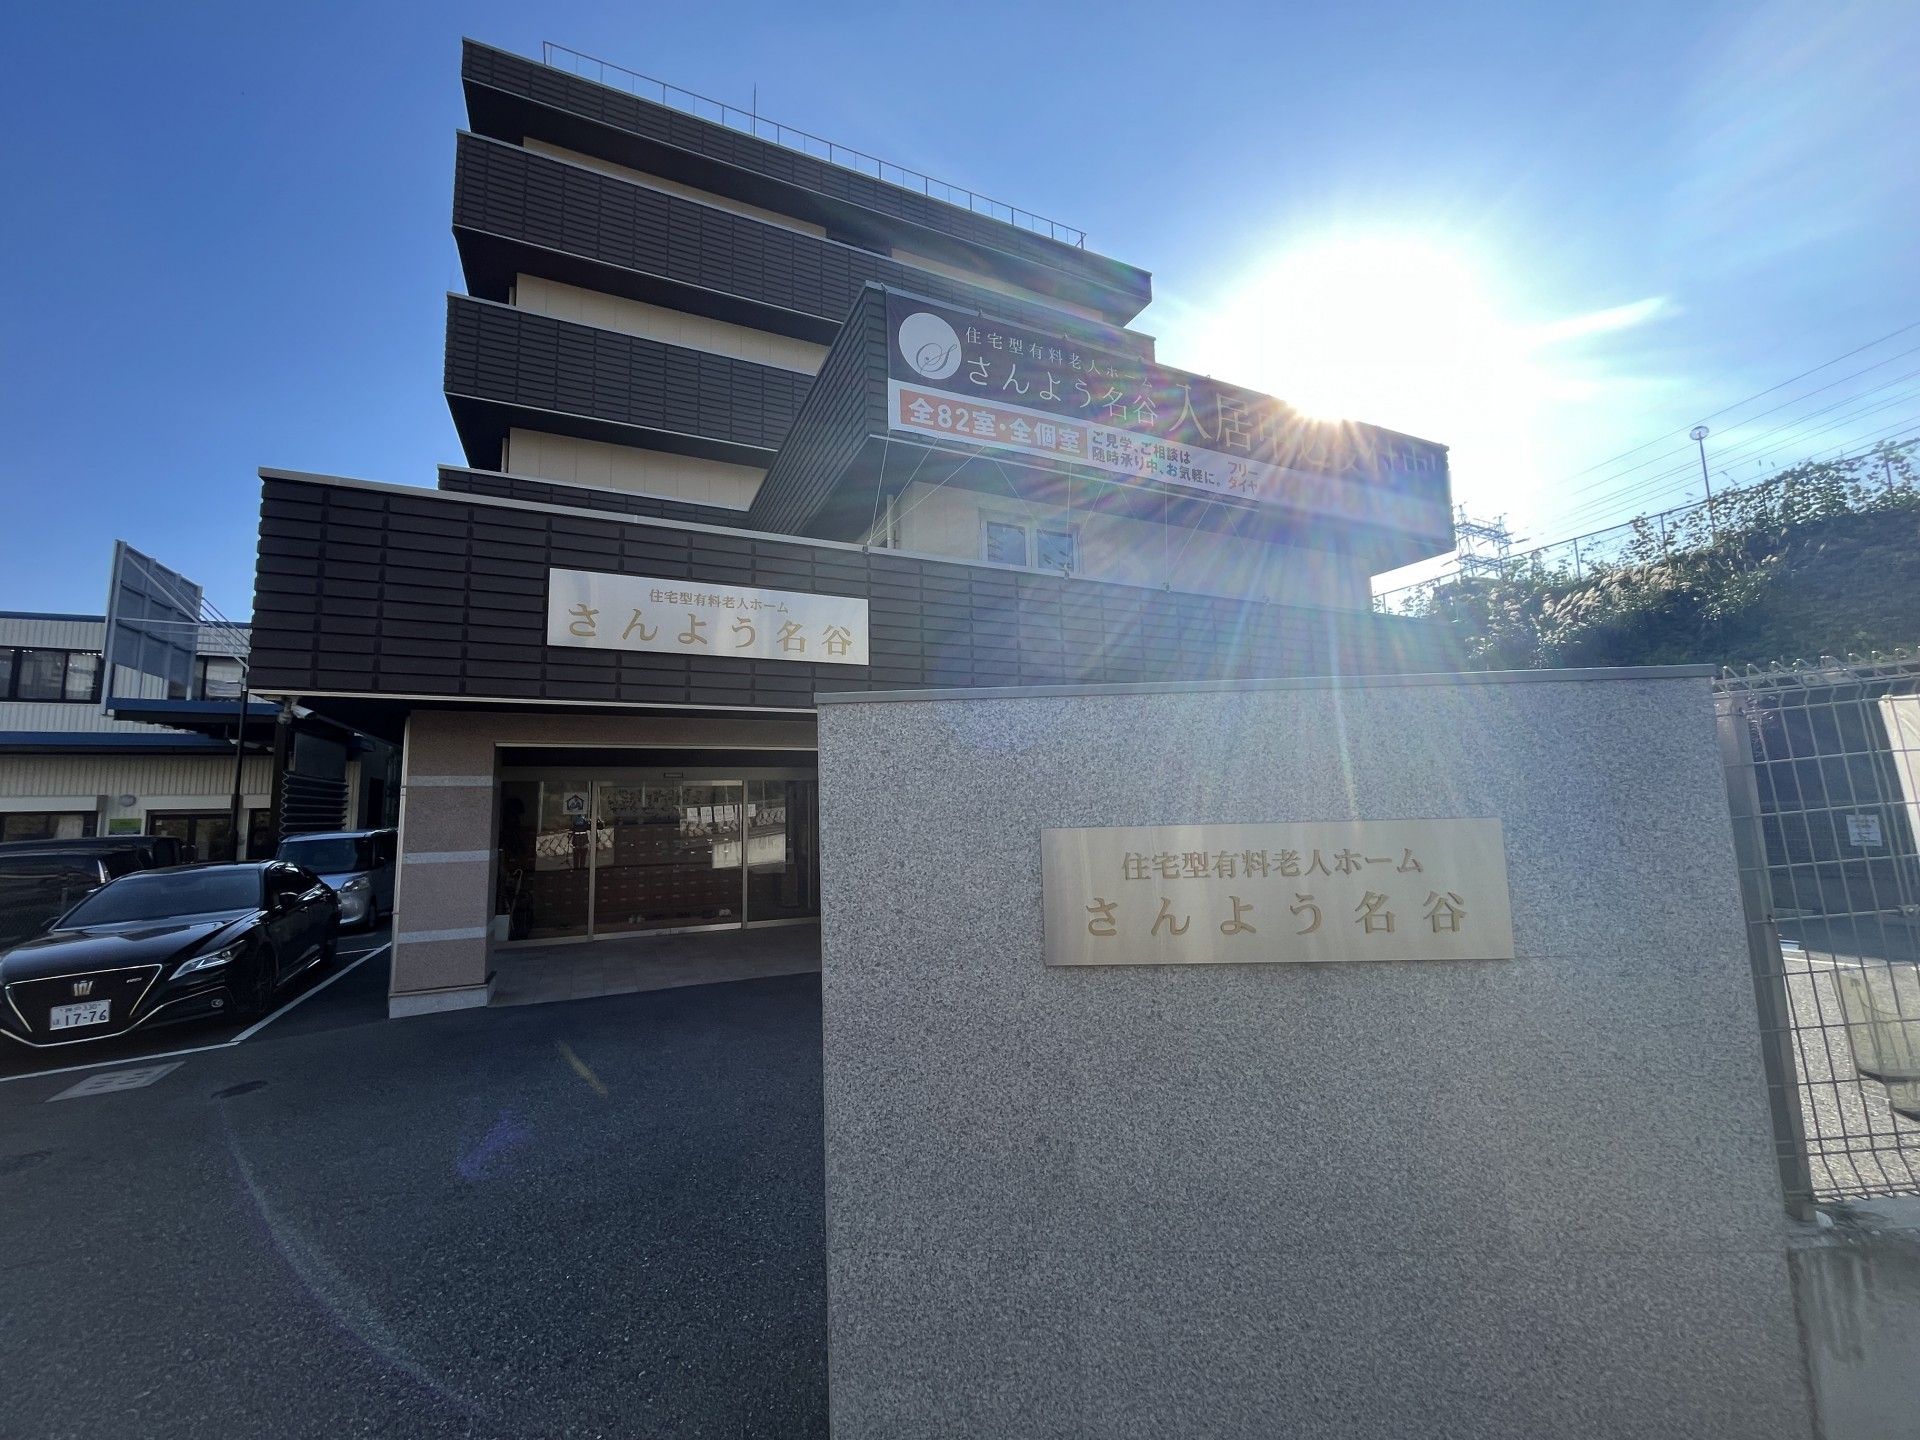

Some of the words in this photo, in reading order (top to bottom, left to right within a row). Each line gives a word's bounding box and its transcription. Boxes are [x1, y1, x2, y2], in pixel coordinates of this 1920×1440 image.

[965, 325, 1154, 390] 住宅型有料老人ホーム
[966, 355, 1159, 426] さんよう名谷
[908, 397, 1081, 454] 全82室・全個室
[1091, 430, 1192, 464] ご見学、ご相談は
[1227, 461, 1258, 477] フリー
[649, 588, 790, 614] 住宅型有料老人ホーム
[568, 602, 853, 657] さんよう名谷
[1121, 848, 1424, 881] 住宅型有料老人ホーム
[1085, 890, 1468, 937] さんよう名谷
[65, 1009, 107, 1026] 17-76
